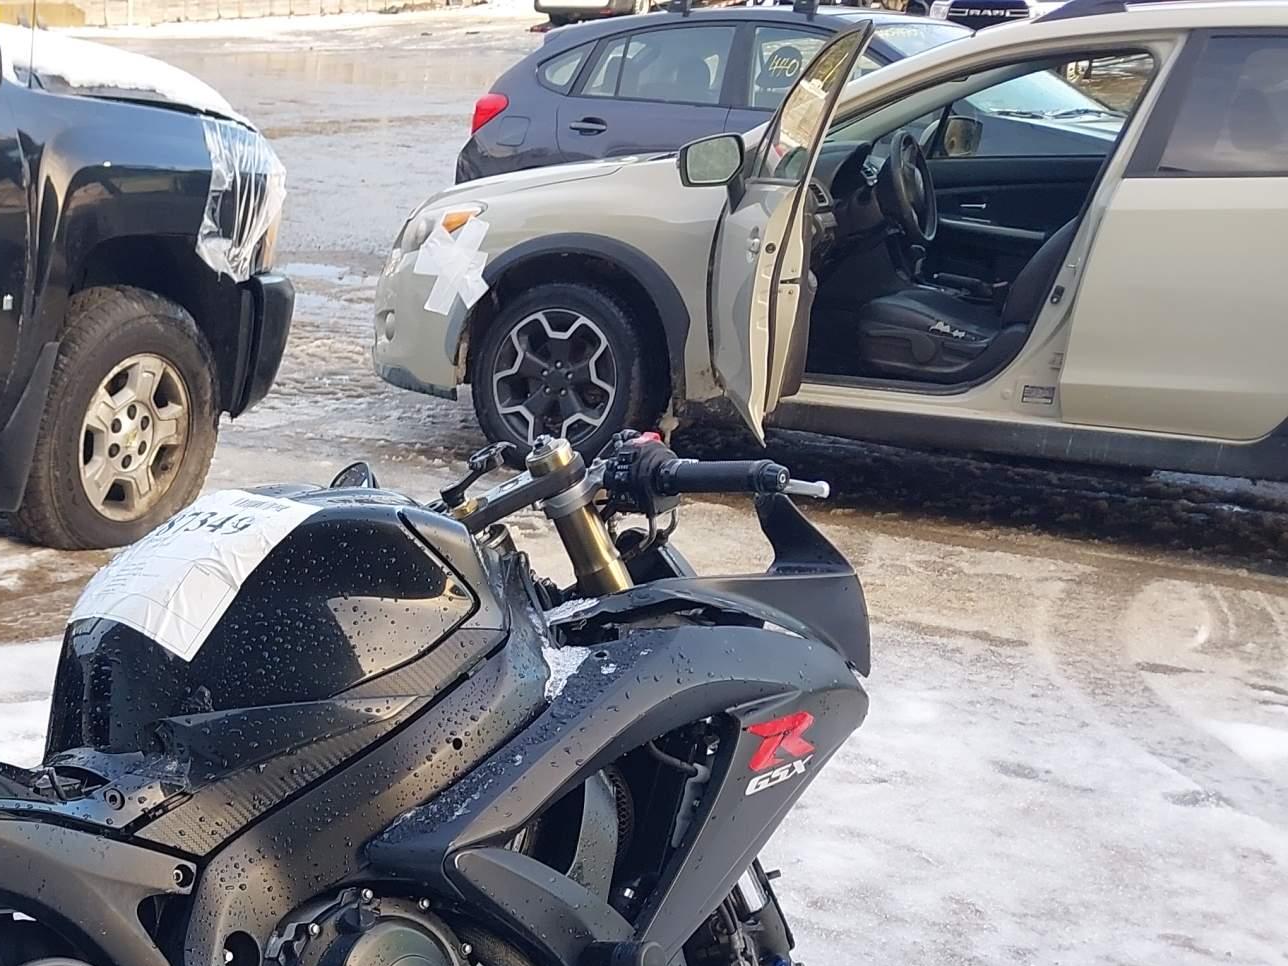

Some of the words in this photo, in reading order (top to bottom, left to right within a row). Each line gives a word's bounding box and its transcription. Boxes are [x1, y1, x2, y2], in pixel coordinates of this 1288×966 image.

[968, 8, 1005, 17] RAM
[748, 711, 815, 772] R
[744, 753, 814, 796] GSX
